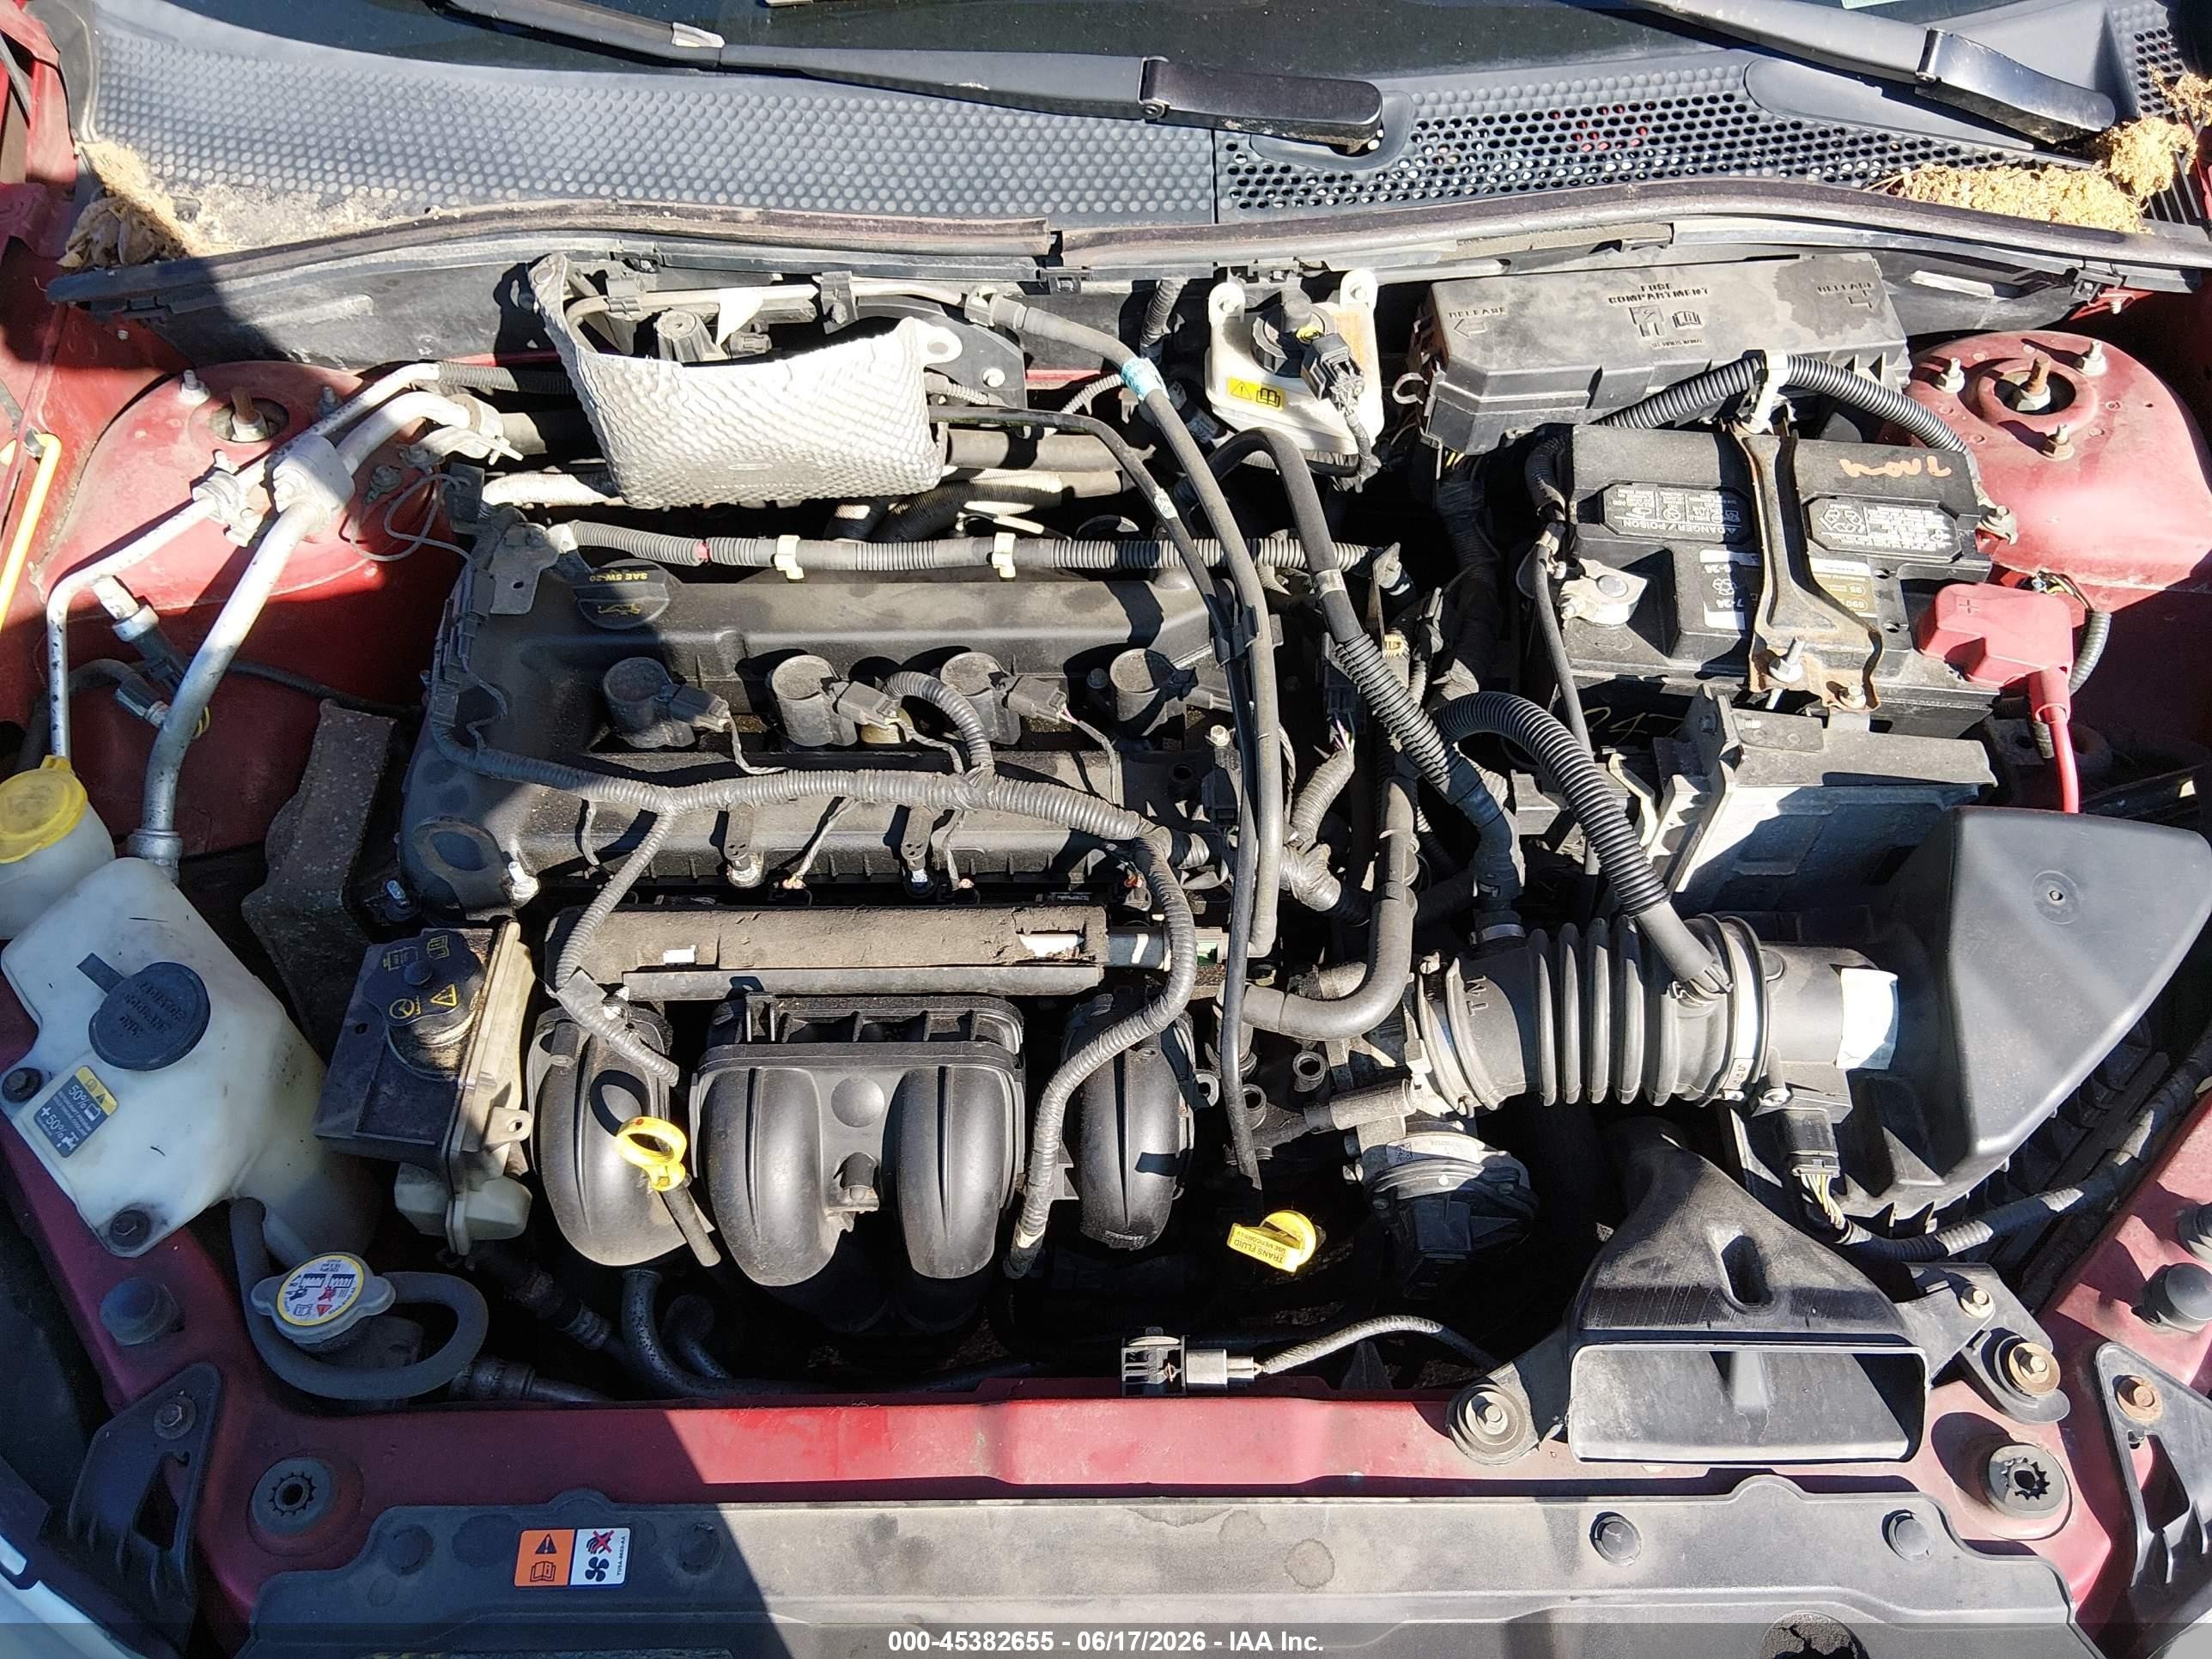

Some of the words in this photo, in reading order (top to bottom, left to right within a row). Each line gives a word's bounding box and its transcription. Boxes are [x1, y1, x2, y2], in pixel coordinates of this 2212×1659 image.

[1640, 283, 1671, 292] FUSE
[1607, 288, 1708, 304] COMPARTMENT
[1449, 306, 1505, 318] RELEASE
[1622, 520, 1666, 530] POISON
[1678, 524, 1726, 534] DANGER
[588, 571, 623, 582] 5W-20
[625, 571, 648, 580] SAE
[69, 1085, 89, 1109] 50%
[1234, 1239, 1256, 1253] FLUID
[1257, 1248, 1284, 1264] TRANS
